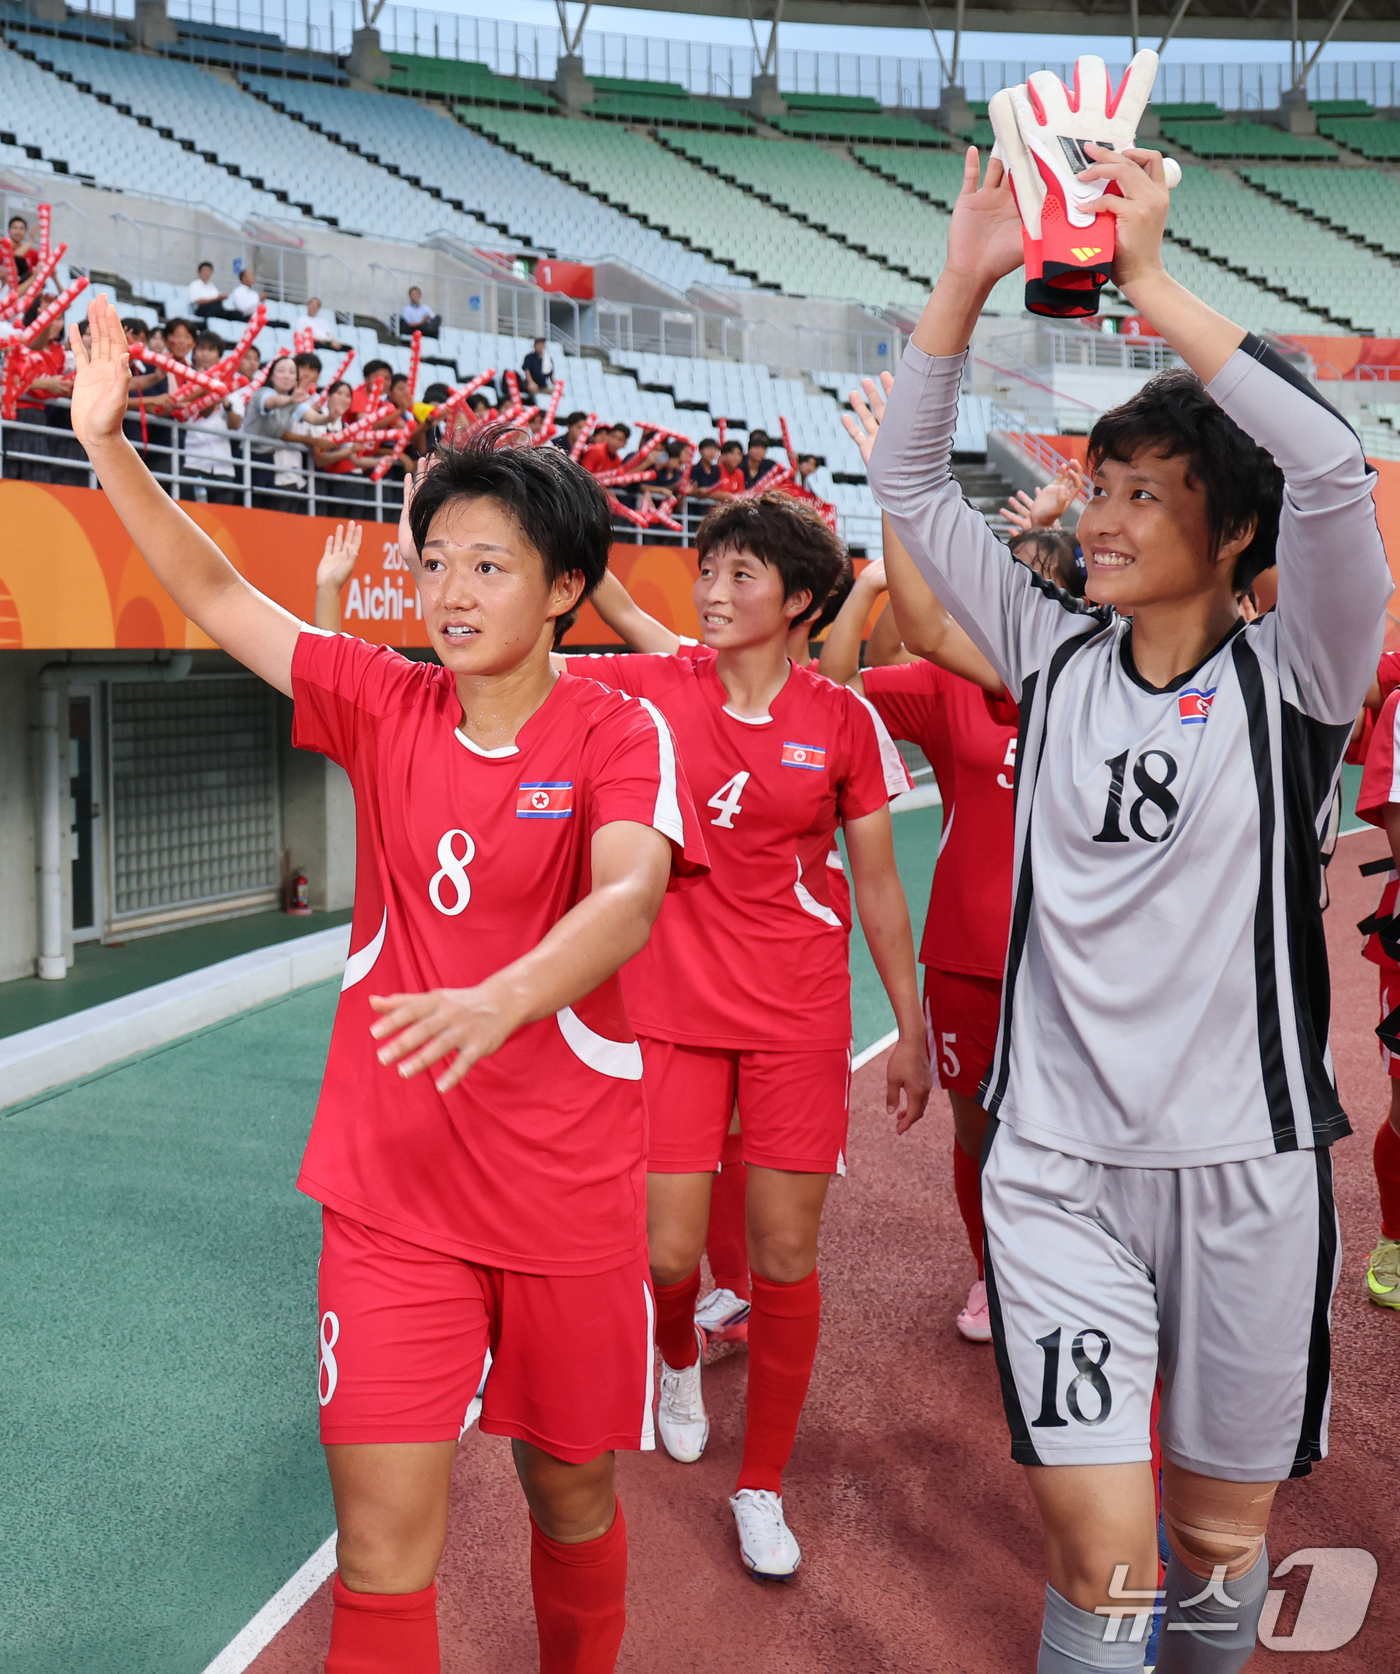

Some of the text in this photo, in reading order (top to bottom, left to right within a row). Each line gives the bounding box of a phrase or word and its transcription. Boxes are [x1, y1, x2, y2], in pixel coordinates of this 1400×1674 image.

[542, 265, 552, 285] 1
[382, 541, 410, 571] 20
[707, 771, 751, 829] 4
[1092, 748, 1180, 843] 18
[428, 829, 476, 916] 8
[941, 1032, 961, 1077] 5
[318, 1311, 340, 1406] 8
[1031, 1326, 1112, 1427] 18
